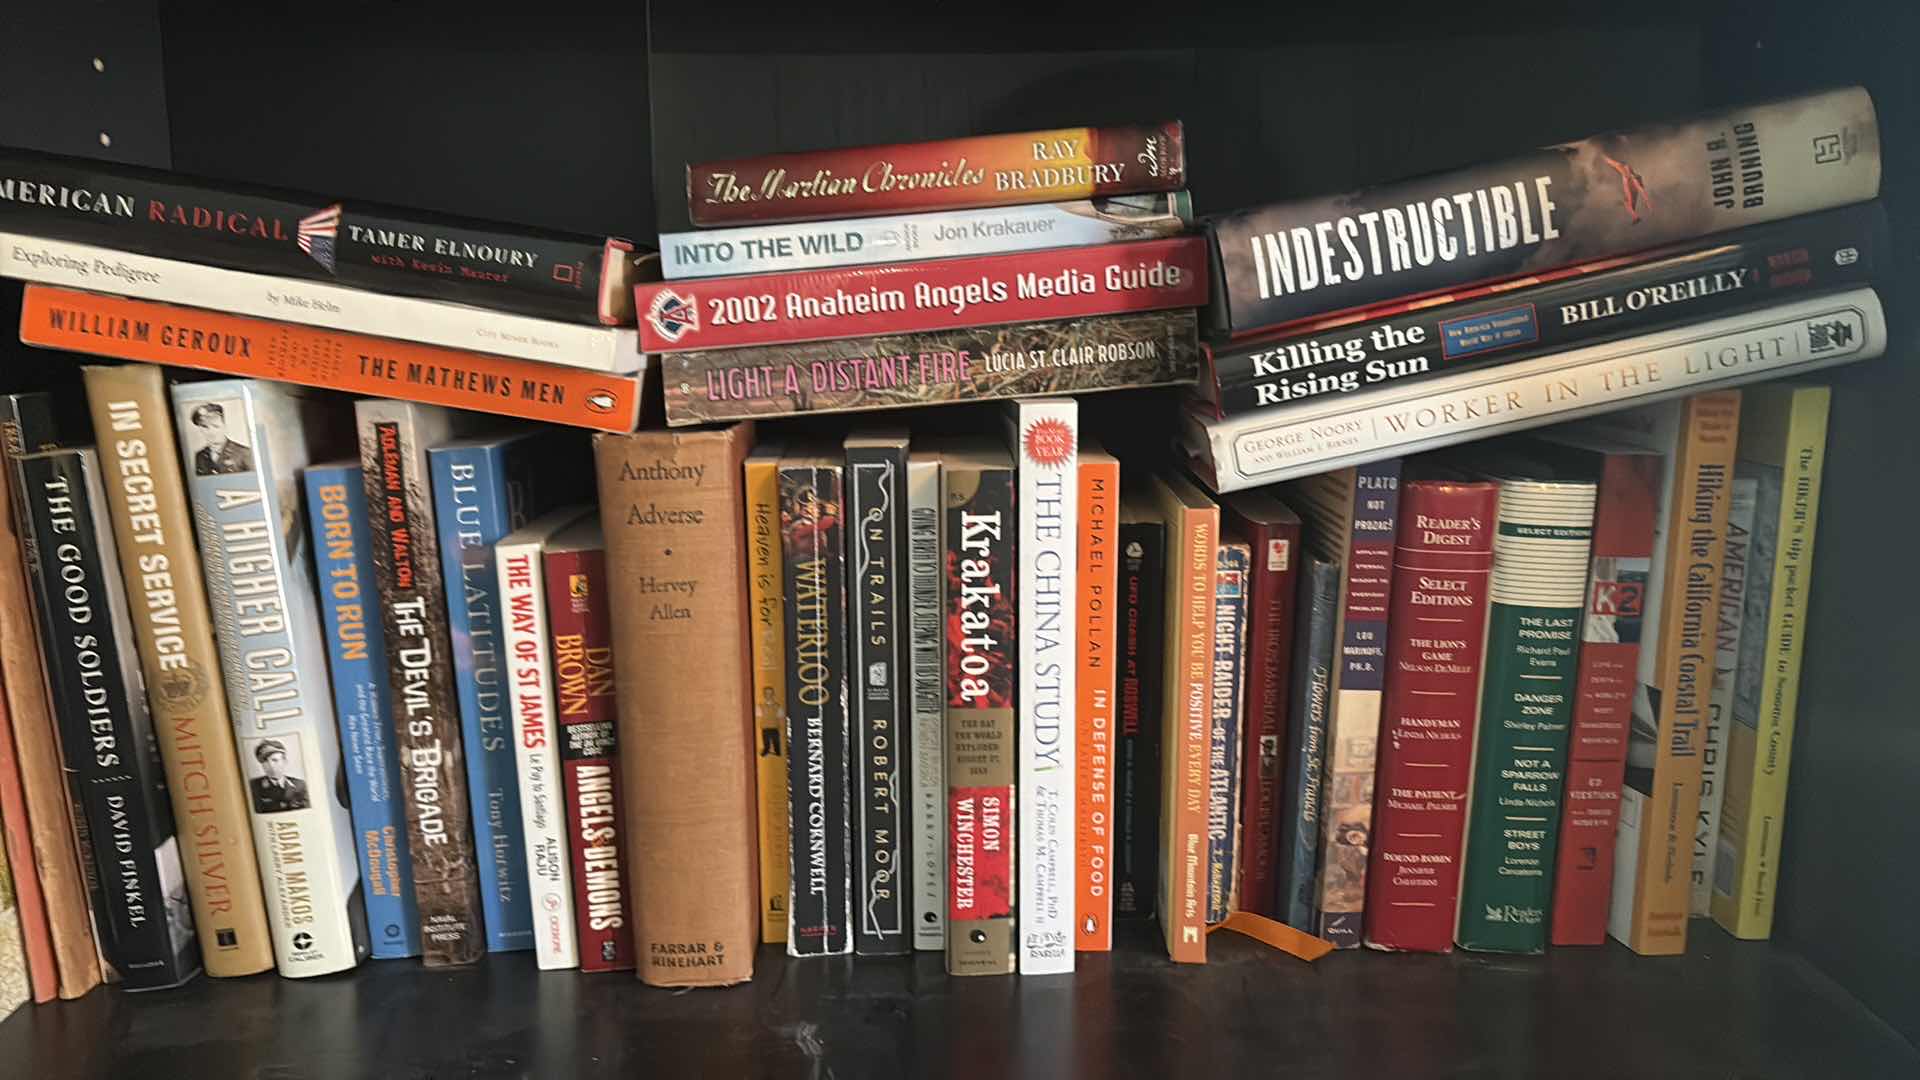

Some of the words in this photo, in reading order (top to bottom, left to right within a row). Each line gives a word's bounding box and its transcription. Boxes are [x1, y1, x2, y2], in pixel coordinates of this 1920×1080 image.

[1032, 139, 1079, 161] RAY
[1734, 122, 1764, 208] BRUNING
[994, 162, 1126, 193] BRADBURY
[1711, 158, 1736, 208] JOHN
[148, 199, 288, 240] RADICAL
[934, 223, 970, 244] Jon
[974, 216, 1056, 239] Krakauer
[1251, 176, 1559, 299] INDESTRUCTIBLE
[349, 225, 425, 252] TAMER
[434, 238, 539, 268] ELNOURY
[674, 241, 734, 265] INTO
[743, 238, 793, 261] THE
[799, 232, 864, 257] WILD
[709, 294, 777, 326] 2002
[786, 285, 906, 319] Anaheim
[914, 278, 1008, 316] Angels
[1017, 267, 1096, 299] Media
[1104, 261, 1182, 291] Guide
[1561, 295, 1624, 324] BILL
[1626, 268, 1748, 312] O'REILLY
[49, 308, 150, 342] WILLIAM
[161, 325, 251, 358] GEROUX
[1249, 339, 1366, 377] Killing
[1370, 325, 1425, 352] the
[358, 355, 397, 380] THE
[408, 361, 512, 398] MATHEWS
[523, 380, 565, 404] MEN
[706, 366, 773, 401] LIGHT
[783, 363, 800, 395] A
[811, 356, 911, 394] DISTANT
[919, 350, 972, 385] FIRE
[1254, 369, 1359, 406] Rising
[1365, 355, 1430, 383] Sun
[1383, 388, 1522, 434] WORKER
[1545, 380, 1579, 403] IN
[1598, 361, 1662, 391] THE
[1683, 337, 1784, 375] LIGHT
[108, 400, 143, 432] IN
[115, 439, 166, 546] SECRET
[618, 460, 706, 487] Anthony
[1357, 476, 1398, 491] PLATO
[1687, 464, 1726, 524] Hiking
[45, 476, 76, 535] THE
[216, 489, 262, 512] A
[320, 483, 356, 560] BORN
[449, 463, 483, 550] BLUE
[627, 503, 704, 524] Adverse
[1034, 473, 1063, 541] THE
[1367, 501, 1384, 510] NOT
[755, 503, 773, 567] Heaven
[868, 507, 884, 541] ON
[1090, 479, 1105, 573] MICHAEL
[1354, 518, 1394, 531] PROZAC!
[1423, 531, 1472, 545] DIGEST
[1517, 527, 1552, 536] SELECT
[1690, 528, 1718, 558] the
[1192, 523, 1209, 571] WORDS
[56, 543, 93, 624] GOOD
[222, 520, 288, 638] HIGHER
[331, 563, 361, 600] TO
[507, 554, 531, 588] THE
[639, 577, 697, 597] Hervey
[1128, 575, 1140, 604] UFO
[1419, 576, 1468, 591] SELECT
[139, 553, 189, 672] SERVICE
[512, 594, 536, 635] WAY
[650, 603, 692, 620] Allen
[869, 557, 887, 646] TRAILS
[961, 510, 1002, 702] Krakatoa
[1034, 549, 1063, 653] CHINA
[1191, 595, 1207, 628] HELP
[1411, 591, 1473, 606] EDITIONS
[1681, 563, 1715, 649] California
[336, 603, 369, 661] RUN
[796, 558, 830, 706] WATERLOO
[1088, 585, 1104, 669] POLLAN
[1127, 607, 1139, 656] CRASH
[1191, 631, 1206, 658] YOU
[1215, 604, 1237, 656] NIGHT
[1410, 639, 1433, 648] THE
[1433, 640, 1466, 649] LION'S
[1519, 629, 1572, 640] PROMISE
[1520, 617, 1543, 626] THE
[1545, 618, 1573, 627] LAST
[461, 563, 505, 751] LATITUDES
[514, 640, 538, 662] OF
[585, 647, 615, 696] DAN
[1190, 662, 1204, 679] BE
[1399, 662, 1433, 672] NELSON
[1422, 652, 1454, 661] GAME
[1517, 645, 1551, 655] Richard
[1551, 646, 1571, 656] Paul
[1529, 657, 1557, 666] Evans
[244, 647, 305, 730] CALL
[517, 667, 540, 688] ST
[555, 634, 589, 715] BROWN
[1212, 660, 1235, 720] RAIDER
[1309, 665, 1329, 721] Flowers
[1674, 653, 1705, 714] Coastal
[74, 634, 121, 768] SOLDIERS
[1033, 662, 1063, 768] STUDY
[1093, 688, 1106, 707] IN
[1187, 682, 1205, 740] POSITIVE
[1514, 693, 1563, 703] DANGER
[1521, 706, 1554, 715] ZONE
[519, 694, 547, 749] JAMES
[1400, 717, 1461, 727] HANDYMAN
[1671, 721, 1698, 757] Trail
[808, 717, 825, 798] BERNARD
[872, 719, 889, 814] ROBERT
[1091, 717, 1106, 803] DEFENSE
[1187, 743, 1202, 786] EVERY
[1211, 744, 1225, 767] THE
[1501, 769, 1560, 780] SPARROW
[1514, 759, 1541, 768] NOT
[1542, 760, 1552, 768] A
[410, 738, 448, 847] BRIGADE
[576, 766, 616, 841] ANGELS
[1187, 789, 1201, 814] DAY
[1208, 768, 1230, 840] ATLANTIC
[1303, 774, 1321, 822] Francis
[1387, 800, 1424, 810] MICHAEL
[1392, 788, 1414, 797] THE
[1415, 789, 1457, 799] PATIENT
[1499, 797, 1523, 806] Linda
[1513, 783, 1548, 792] FALLS
[107, 796, 134, 852] DAVID
[171, 717, 214, 816] MITCH
[195, 824, 232, 917] SILVER
[982, 796, 1000, 851] SIMON
[1035, 796, 1046, 843] THOMAS
[1091, 811, 1104, 837] OF
[1504, 830, 1547, 839] STREET
[275, 820, 304, 865] ADAM
[534, 844, 548, 876] RAJU
[808, 802, 826, 896] CORNWELL
[873, 829, 891, 899] MOOR
[955, 798, 975, 910] WINCHESTER
[1186, 833, 1200, 853] Blue
[1383, 852, 1419, 862] ROUND
[1421, 854, 1452, 863] ROBIN
[1508, 841, 1540, 850] BOYS
[119, 859, 147, 927] FINKEL
[583, 846, 623, 931] DEMONS
[1089, 844, 1105, 898] FOOD
[1185, 855, 1199, 898] Mountain
[284, 871, 315, 926] MAKOS
[1184, 899, 1198, 919] Arts
[651, 943, 706, 954] FARRAR
[652, 955, 724, 967] RINEHART
